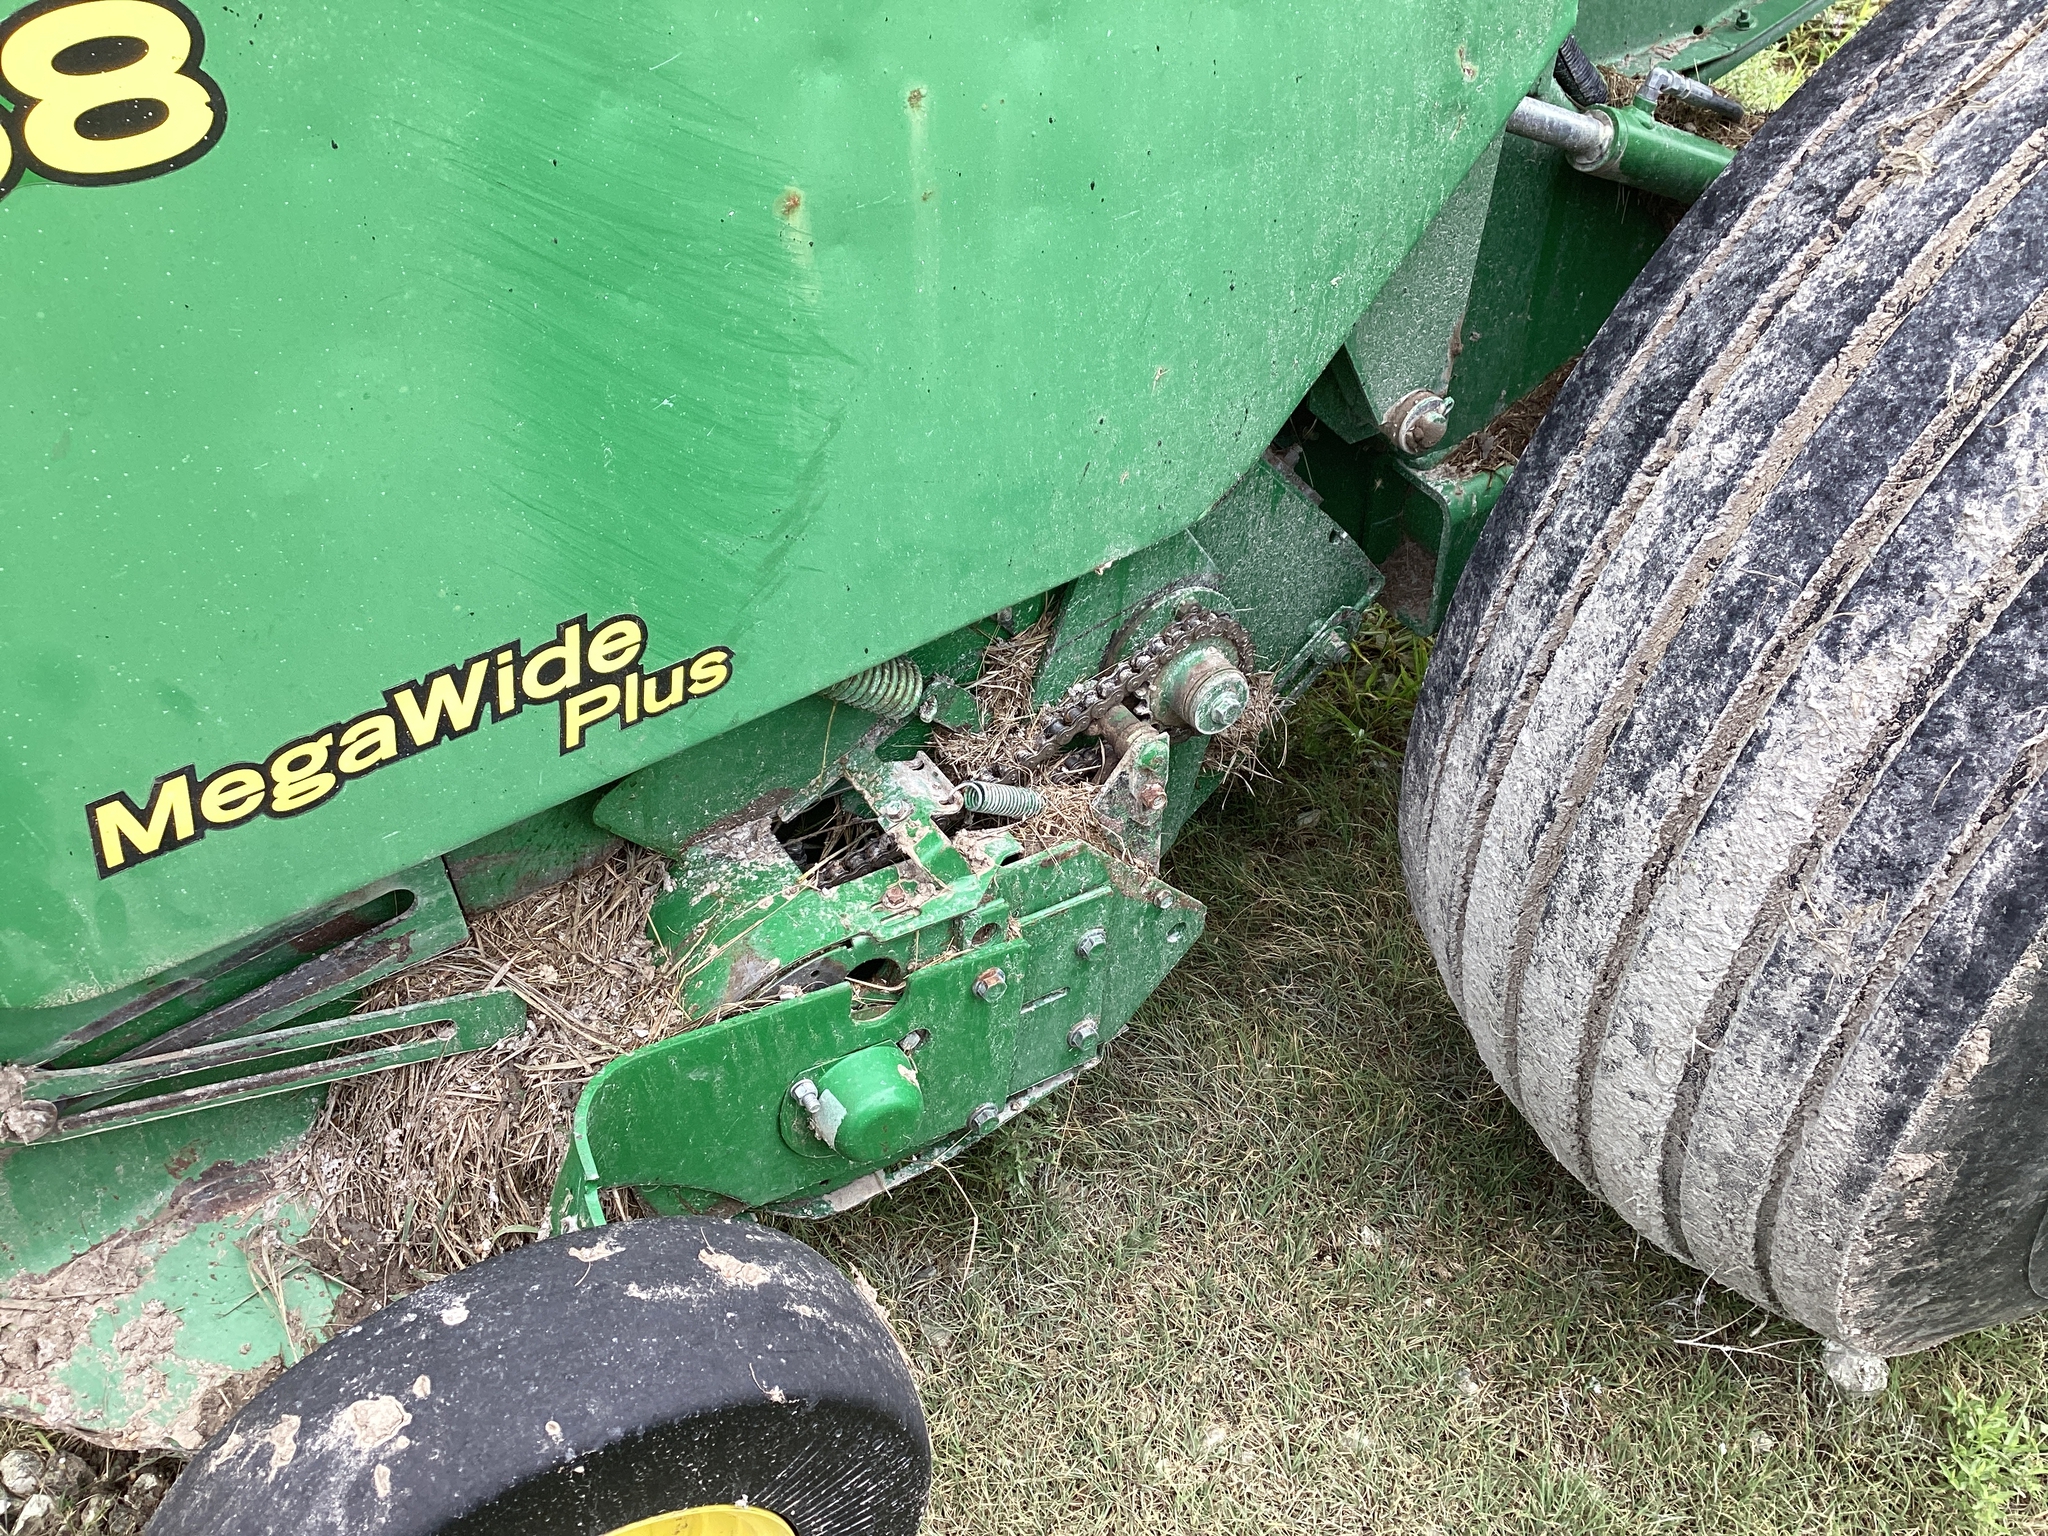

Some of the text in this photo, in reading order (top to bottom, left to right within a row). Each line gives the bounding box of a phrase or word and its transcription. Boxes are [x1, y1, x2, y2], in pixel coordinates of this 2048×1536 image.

[0, 0, 225, 192] 8
[91, 617, 644, 872] MegaWide
[563, 649, 730, 751] Plus
